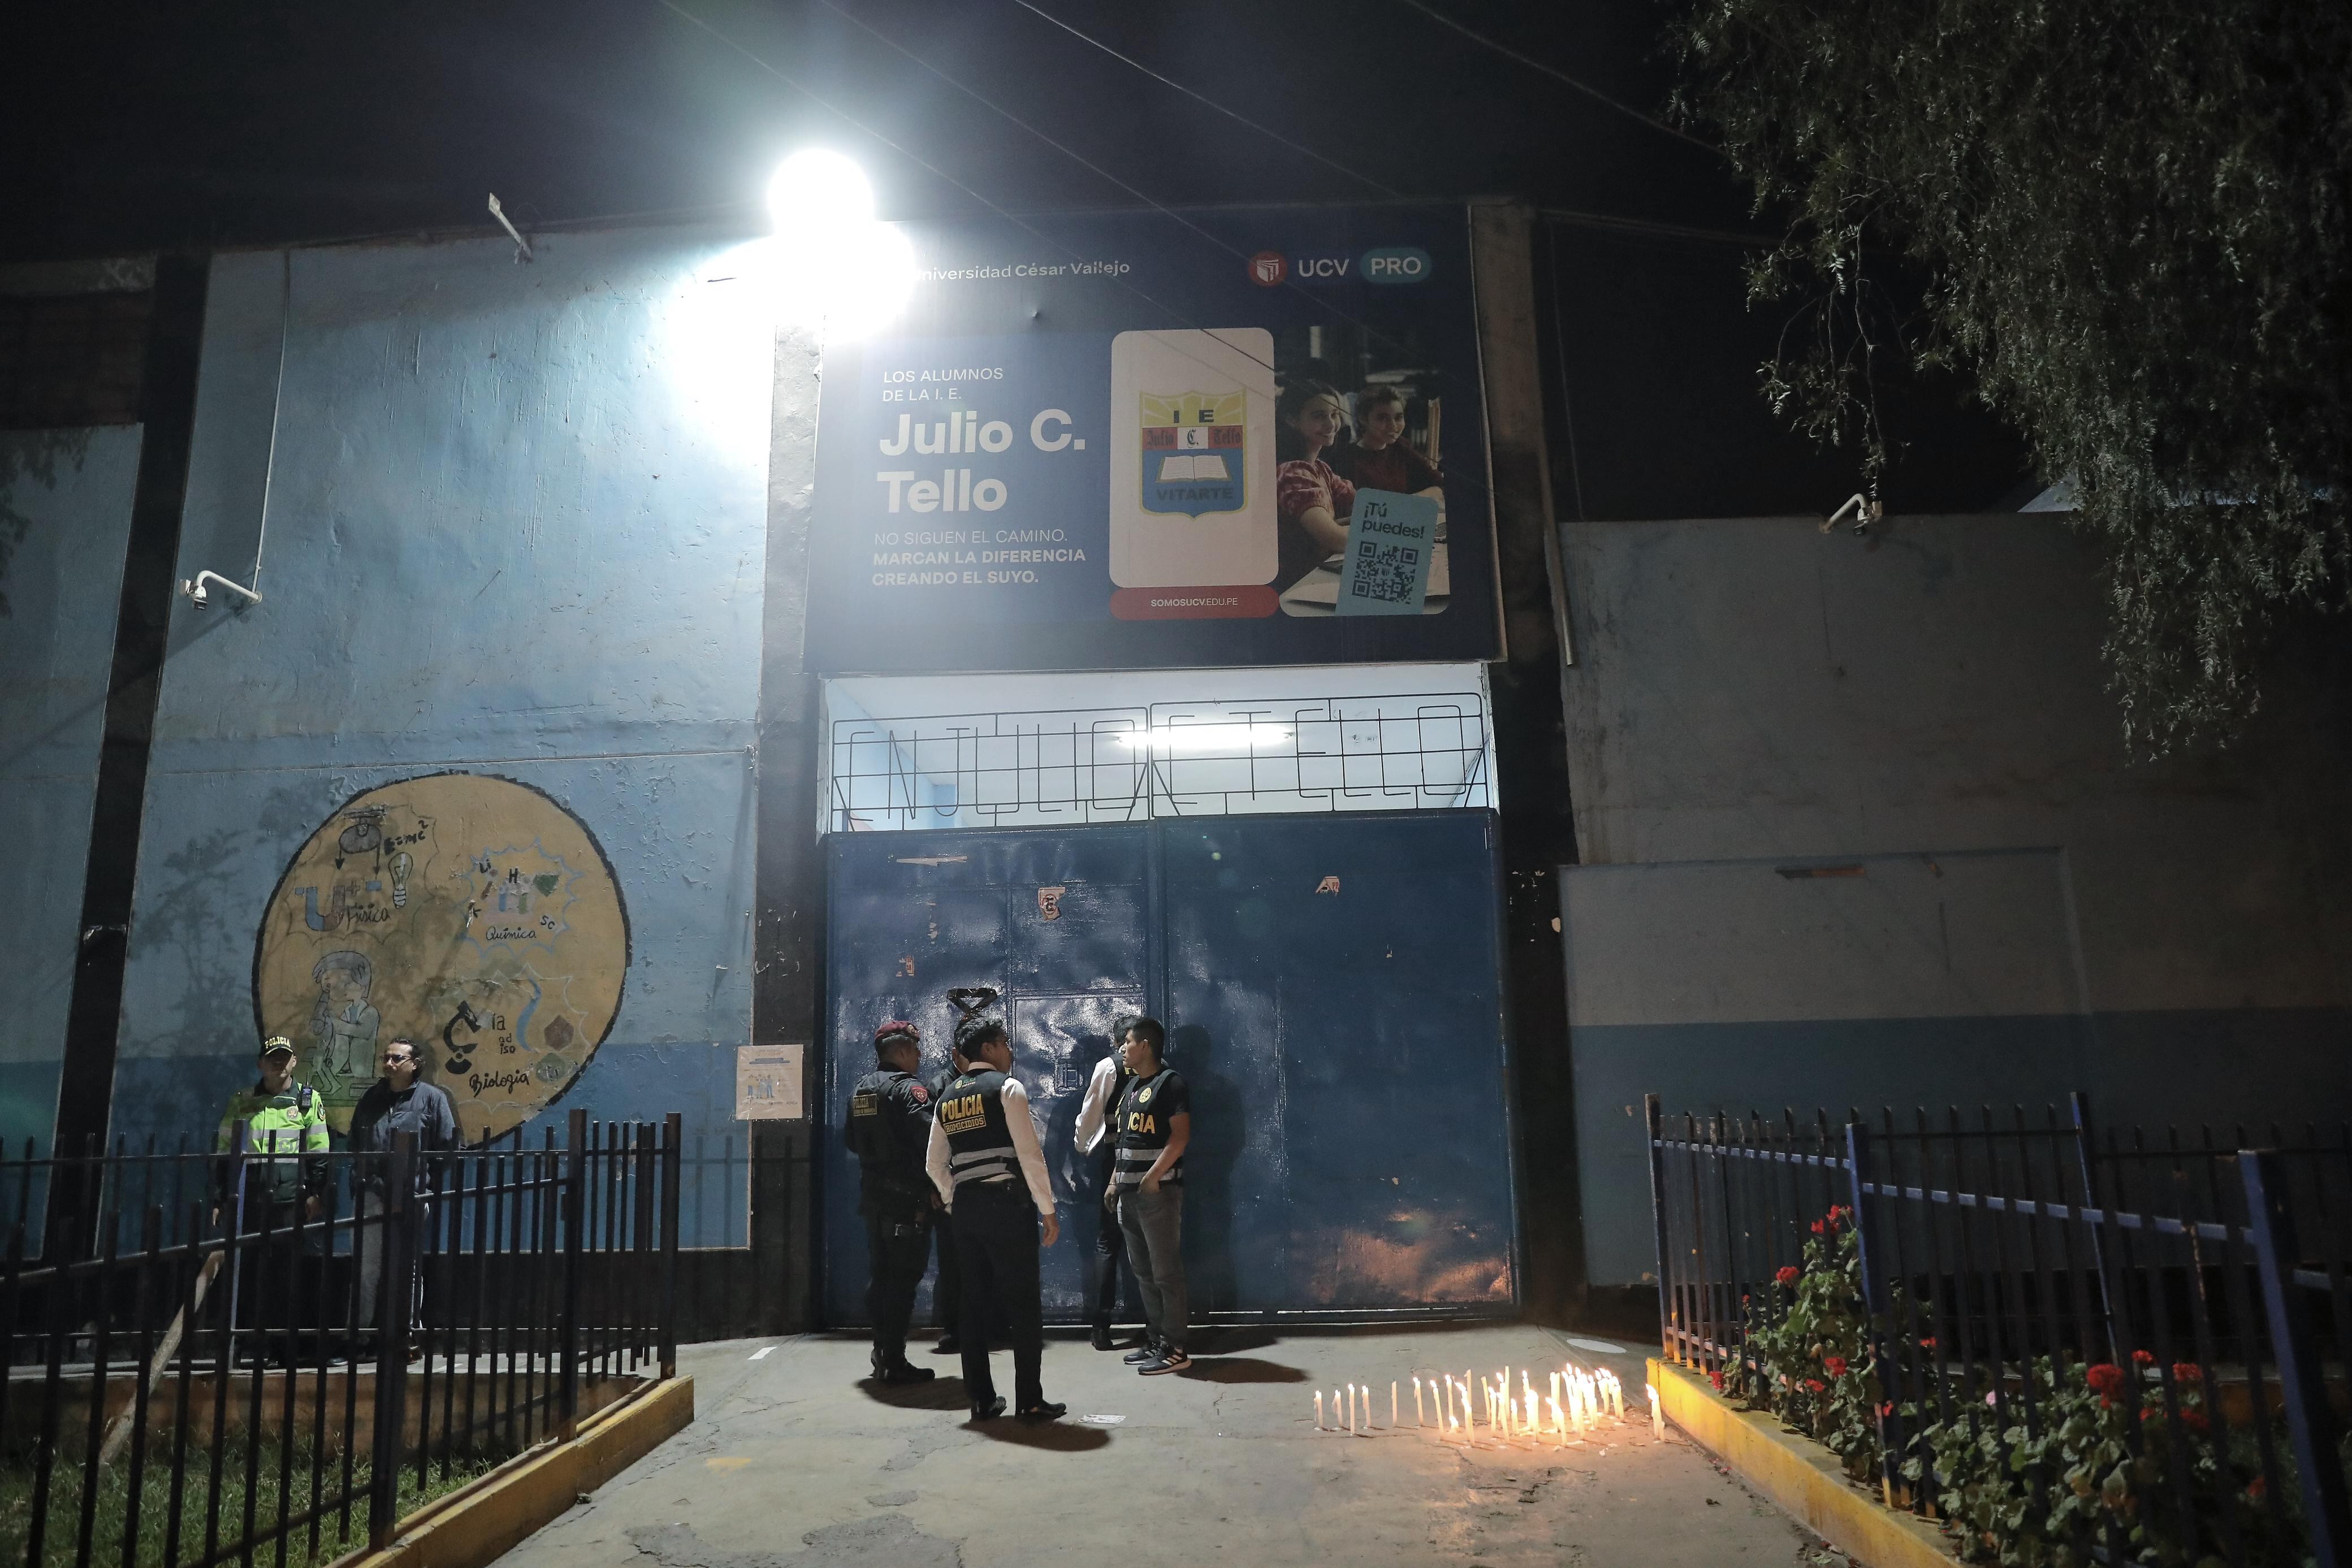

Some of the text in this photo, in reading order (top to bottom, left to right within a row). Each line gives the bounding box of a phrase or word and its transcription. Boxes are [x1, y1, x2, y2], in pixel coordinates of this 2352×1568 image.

[1015, 262, 1066, 278] César
[1070, 260, 1130, 277] Vallejo
[1299, 257, 1421, 278] UCV PRO
[883, 367, 1004, 383] LOS ALUMNOS
[883, 389, 903, 402] DE
[908, 389, 930, 401] LA
[948, 388, 962, 399] E.
[1173, 409, 1214, 423] I E
[879, 409, 1086, 456] Julio C.
[877, 469, 1008, 513] Tello
[1157, 488, 1234, 501] VITARTE
[1364, 502, 1387, 518] ¡Tú
[875, 529, 1068, 545] NO SIGUEN EL CAMINO.
[1361, 519, 1425, 539] puedes!
[874, 549, 1086, 566] MARCAN LA DIFERENCIA
[872, 570, 1039, 586] CREANDO EL SUYO.
[1151, 597, 1238, 607] SOMOSUCV.EDU.PE
[509, 867, 518, 883] H
[265, 1036, 291, 1049] POLICIA
[945, 1117, 984, 1133] HOMICIDIOS
